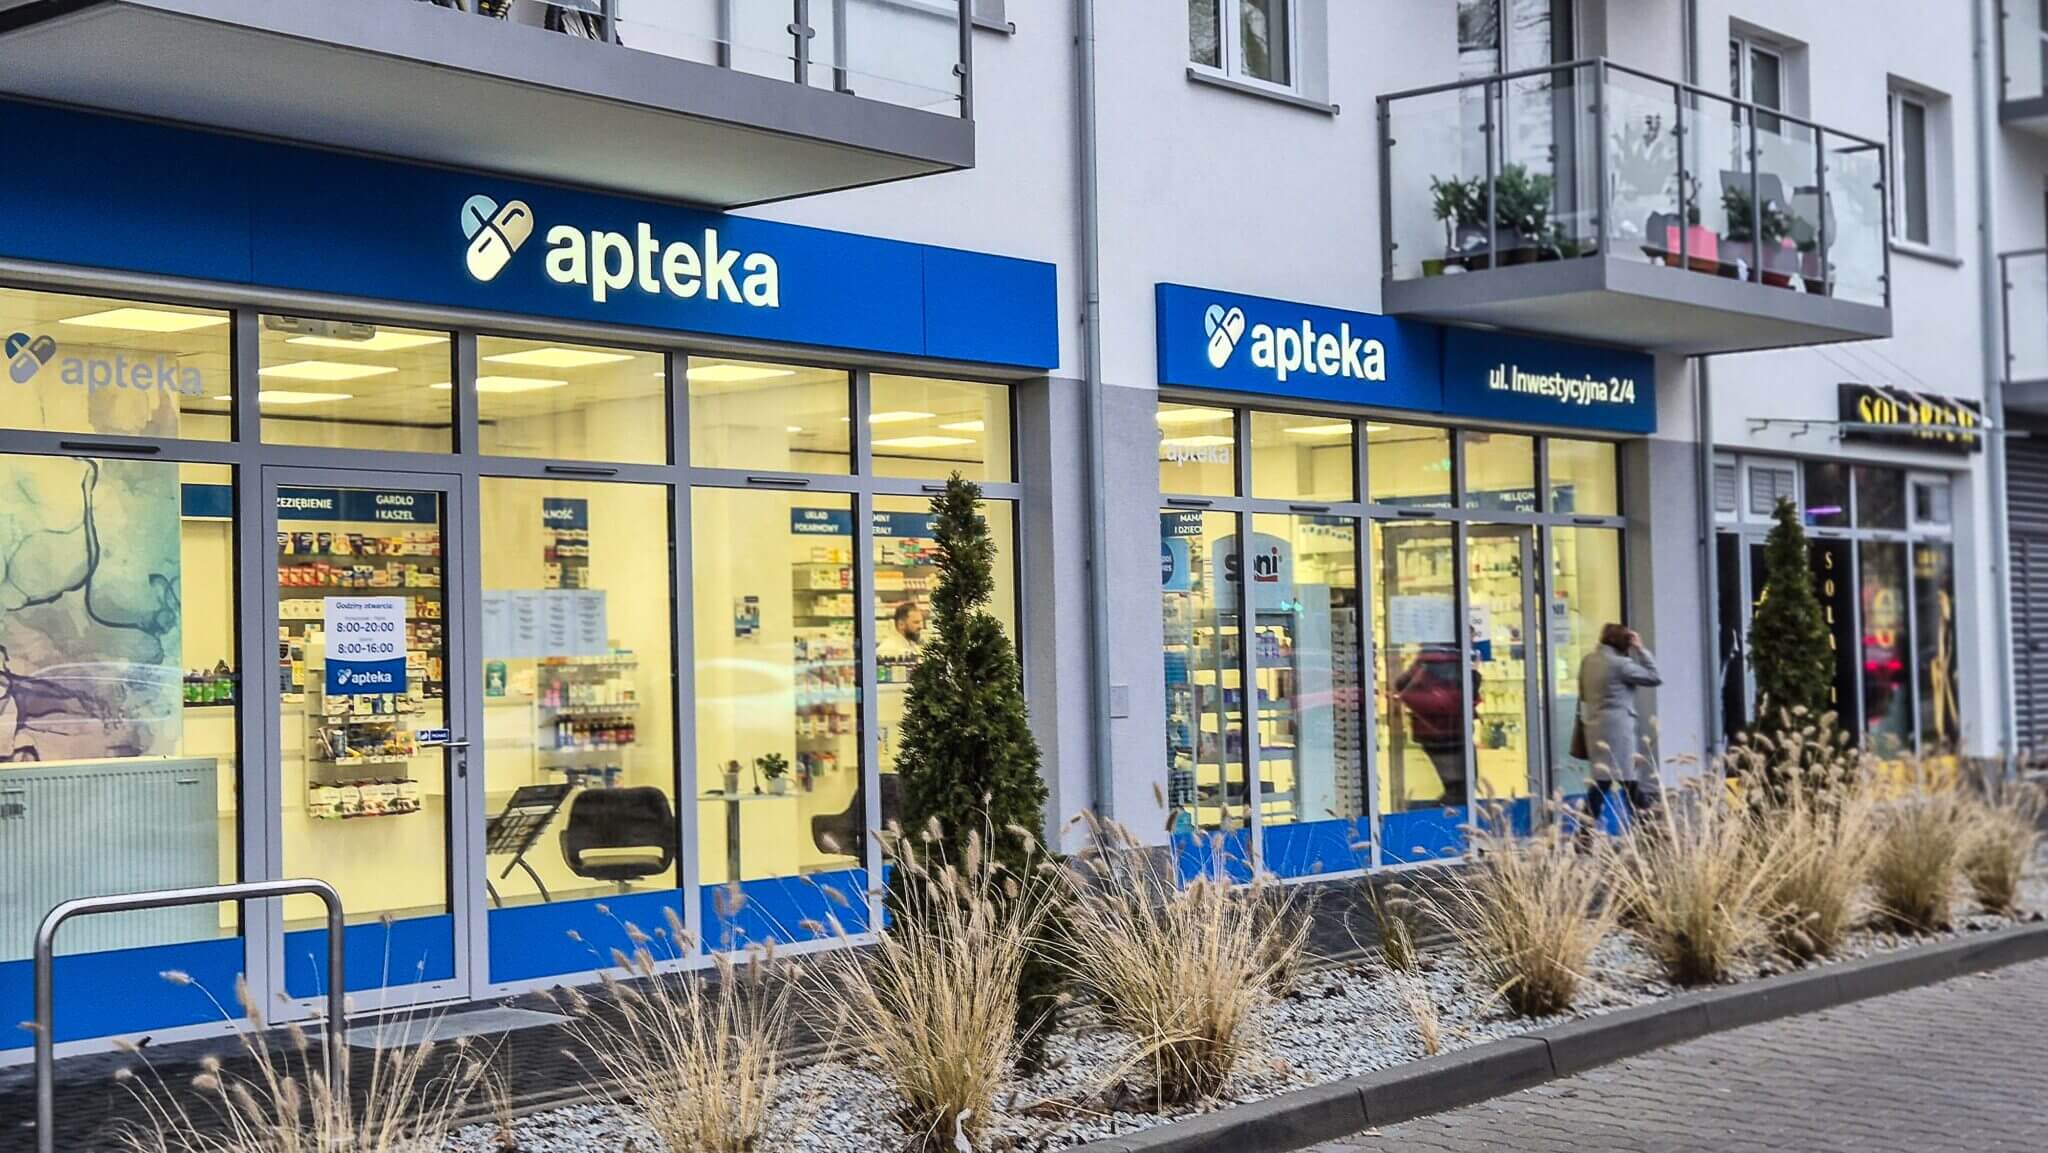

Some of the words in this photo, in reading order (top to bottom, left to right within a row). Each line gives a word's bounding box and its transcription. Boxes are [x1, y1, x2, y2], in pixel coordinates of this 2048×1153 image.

[545, 222, 780, 308] apteka
[1250, 319, 1386, 382] apteka
[60, 351, 205, 395] apteka
[1489, 363, 1509, 390] ul.
[1511, 365, 1608, 405] Inwestycyjna
[1610, 377, 1636, 404] 2/4
[1166, 443, 1230, 467] apteka
[336, 622, 395, 633] 8:00-20:00
[337, 643, 395, 654] 8:00-16:00
[351, 670, 393, 686] apteka
